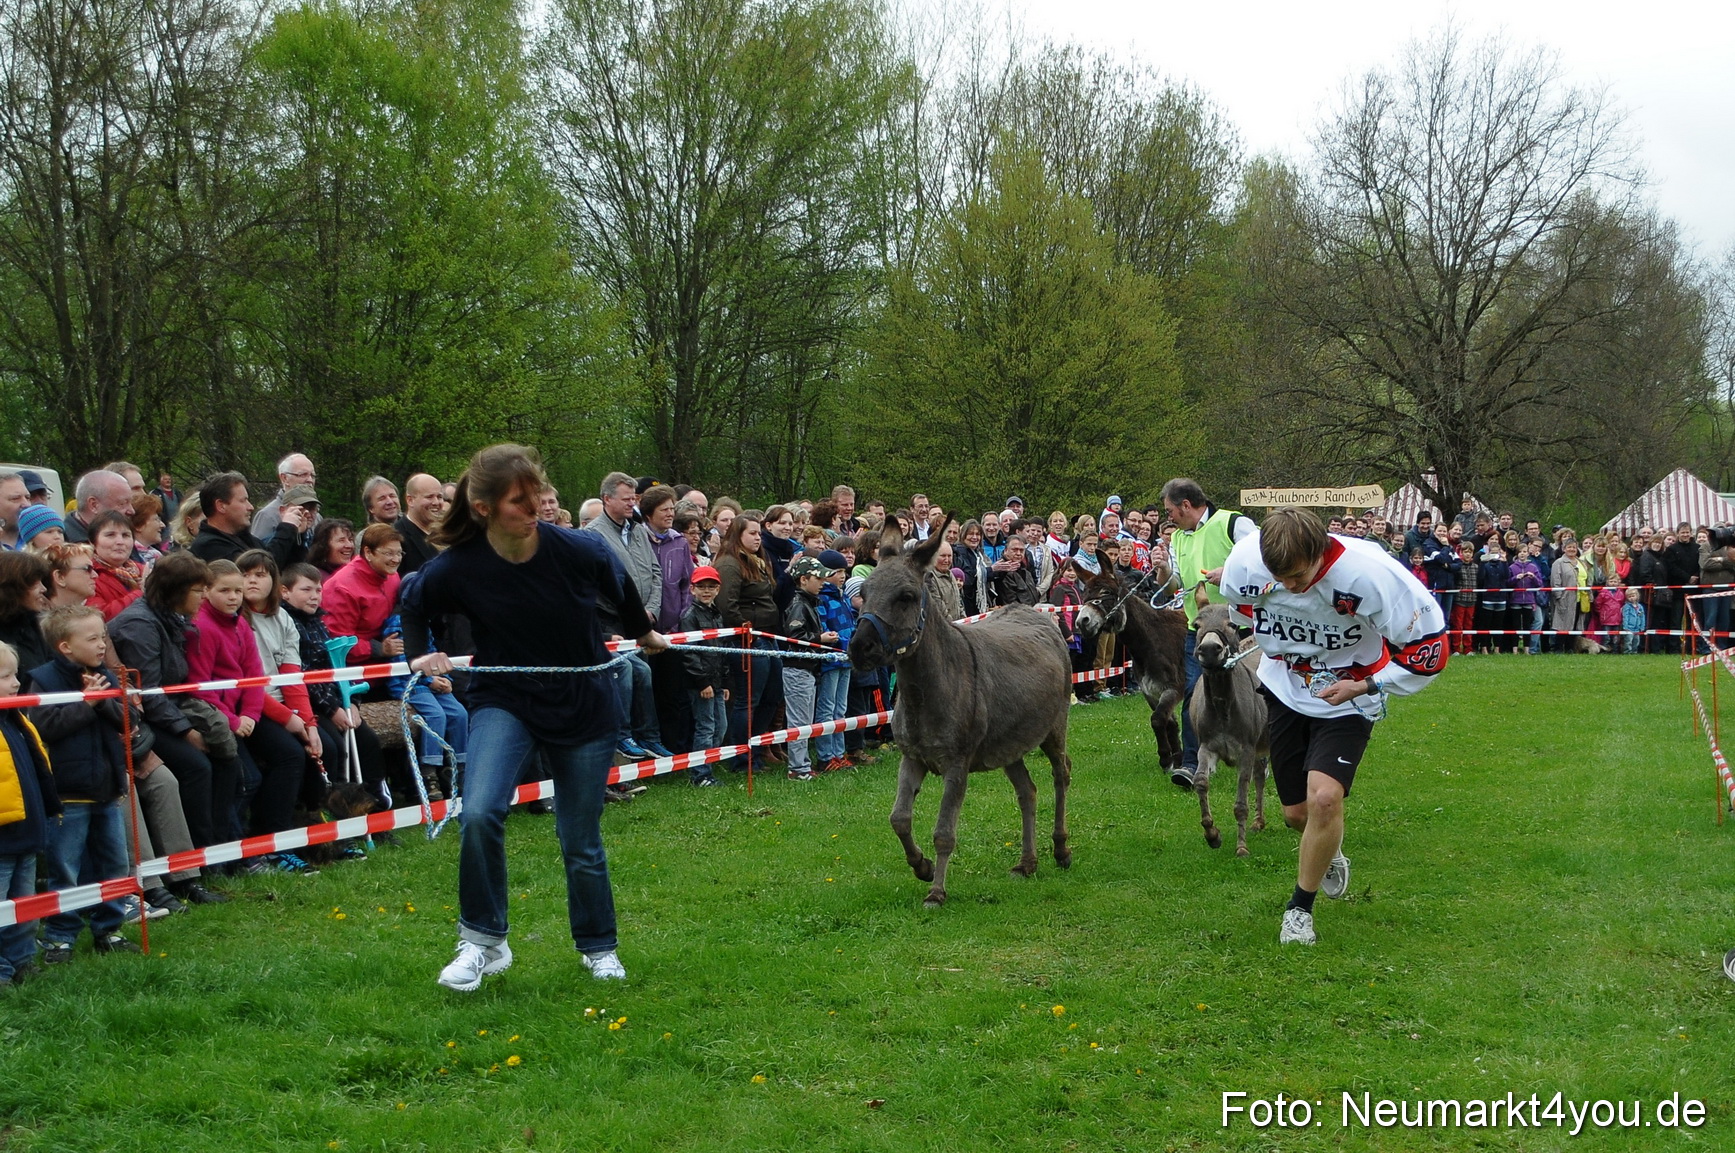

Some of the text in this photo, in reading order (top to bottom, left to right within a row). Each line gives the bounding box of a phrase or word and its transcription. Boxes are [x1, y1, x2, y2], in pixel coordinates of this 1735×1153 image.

[1268, 491, 1319, 503] Haubner's
[1325, 490, 1355, 504] Ranch
[1253, 607, 1362, 650] EAGLES
[1270, 612, 1339, 632] NEUMARKT
